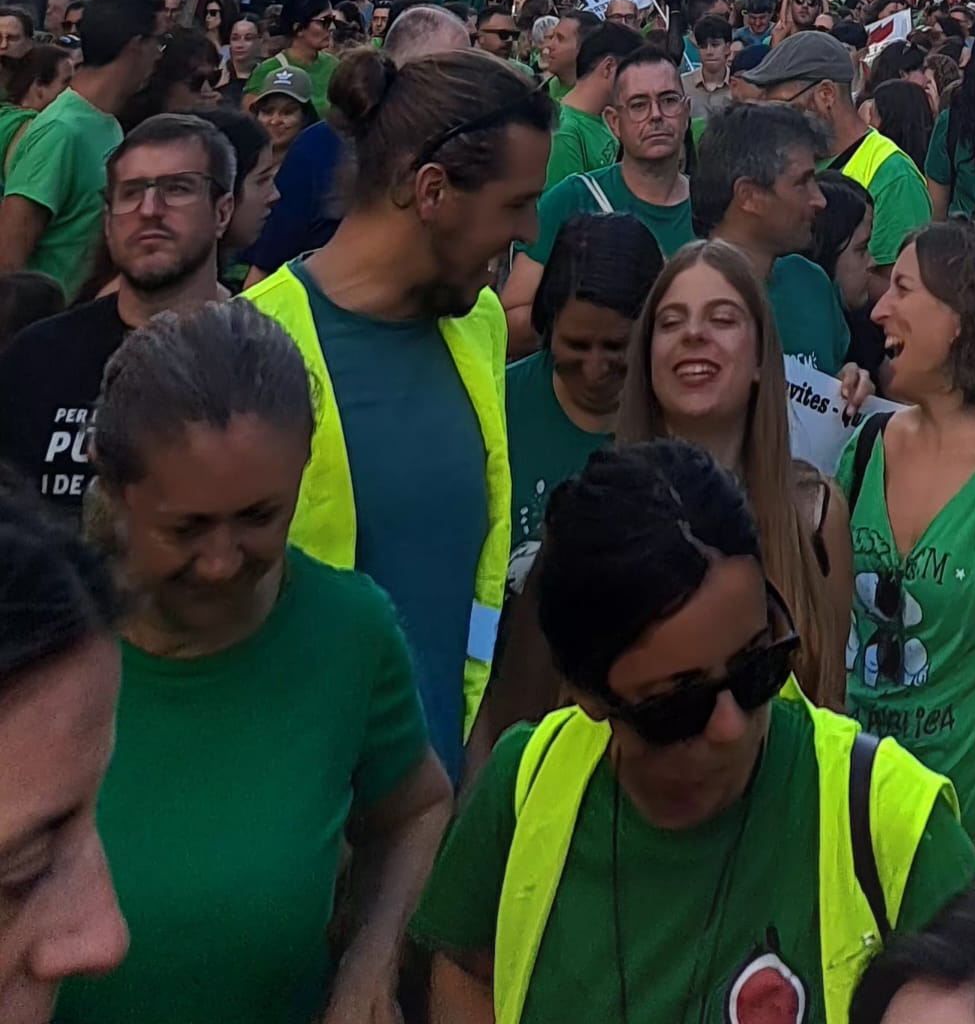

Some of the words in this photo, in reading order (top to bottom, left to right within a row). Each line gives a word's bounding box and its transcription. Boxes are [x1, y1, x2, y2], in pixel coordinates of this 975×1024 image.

[787, 381, 830, 414] vites
[54, 407, 88, 424] PER
[52, 474, 85, 495] DE
